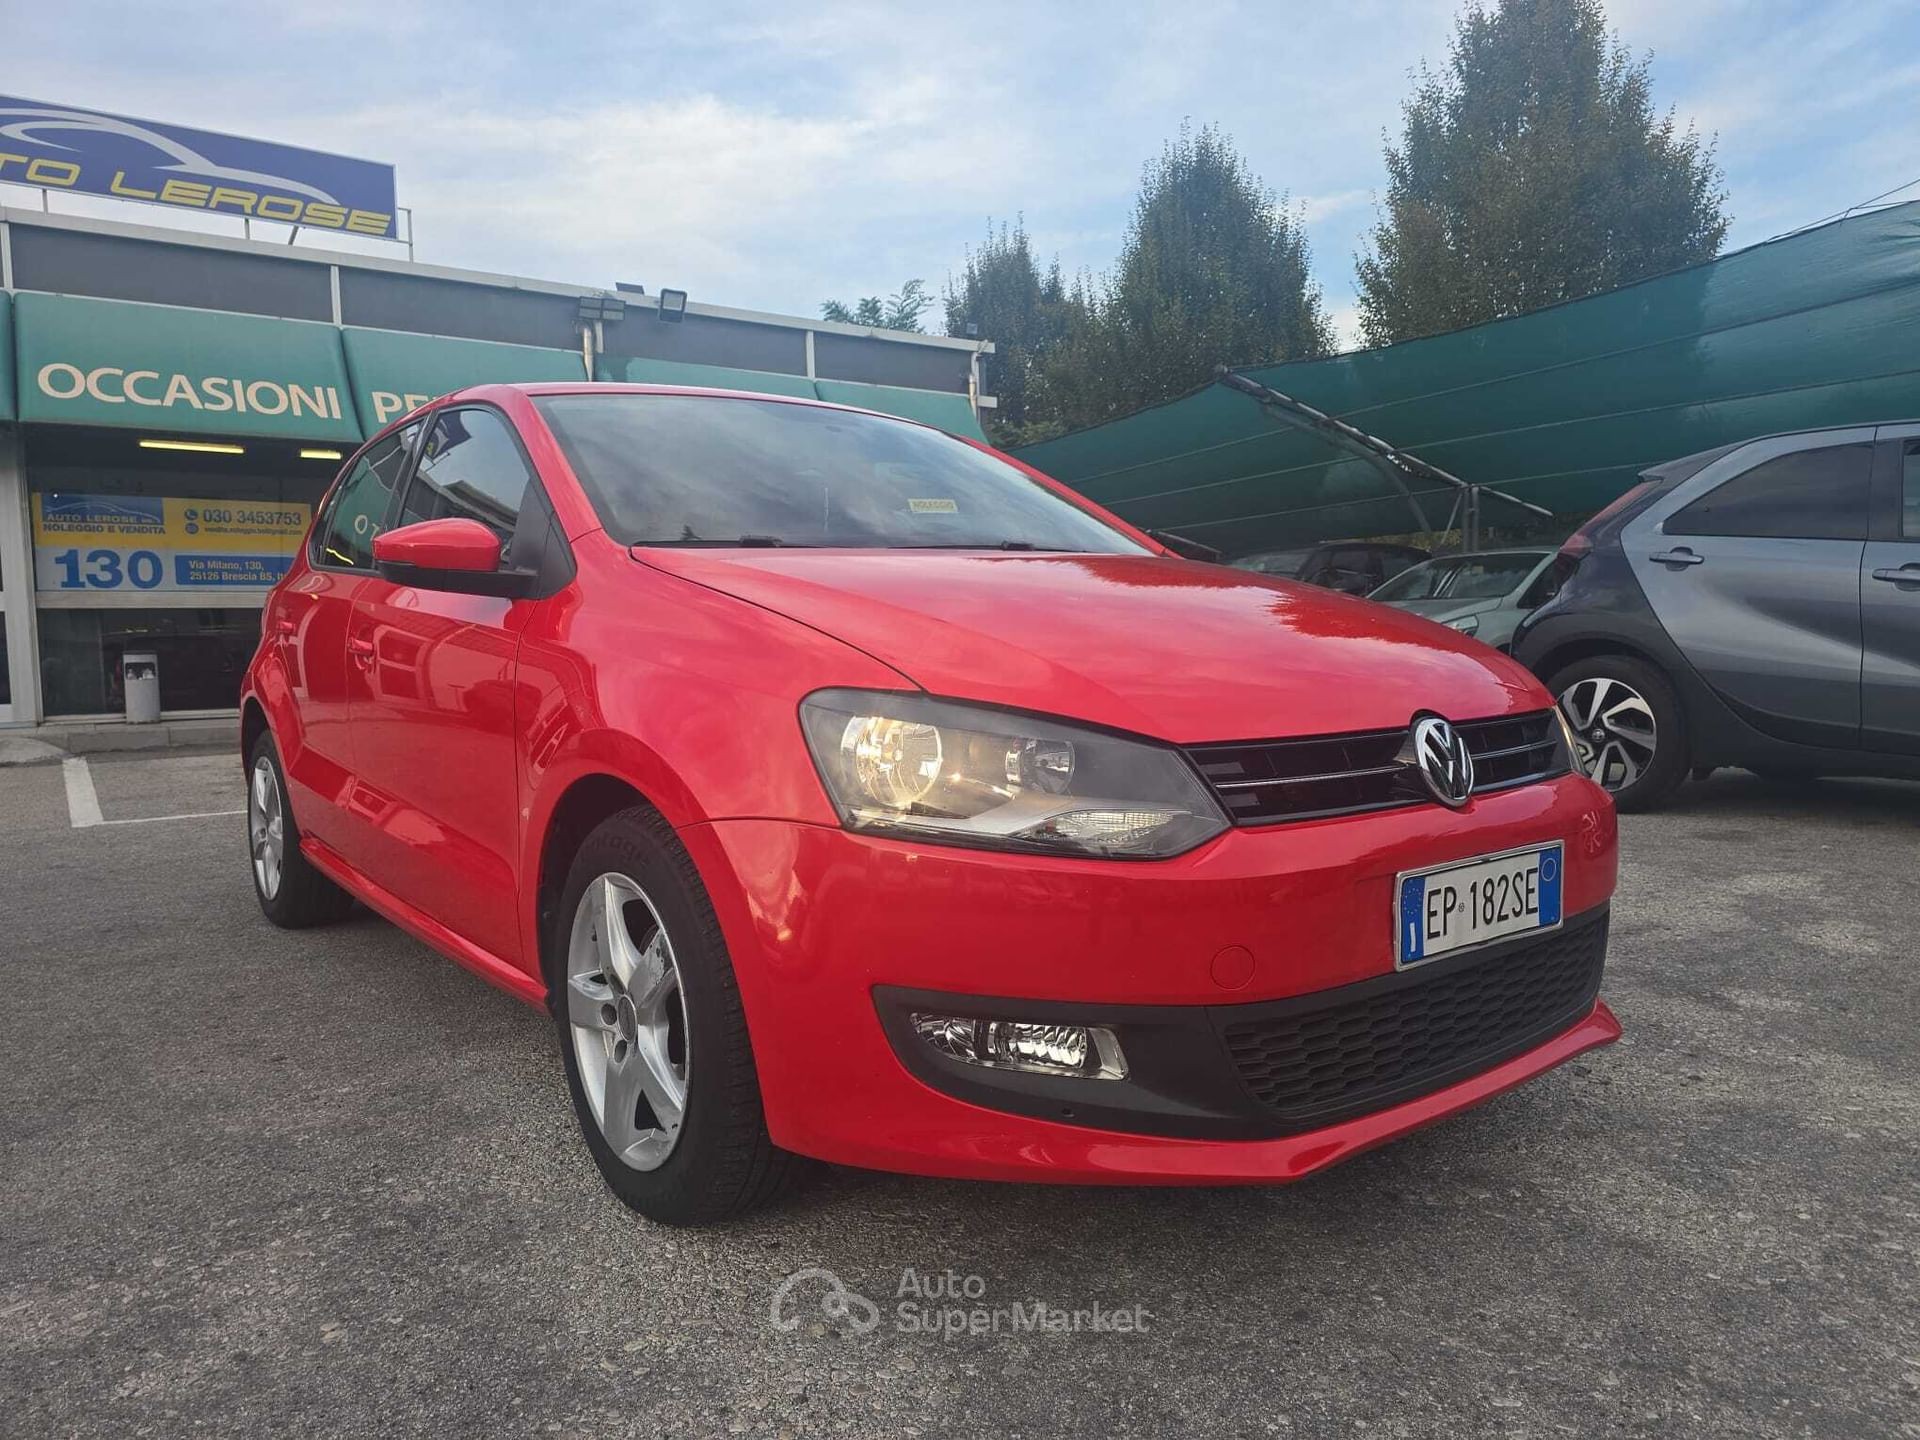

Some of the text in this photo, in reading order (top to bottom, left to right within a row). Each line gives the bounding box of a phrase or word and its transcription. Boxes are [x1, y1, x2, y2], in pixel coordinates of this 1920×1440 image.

[110, 171, 391, 235] LEROSE
[37, 362, 438, 424] OCCASIONI PE
[47, 513, 81, 523] AUTO
[86, 514, 138, 524] LEROSE
[203, 508, 302, 526] 030 3453753
[43, 523, 166, 535] NOLEGGIO E VENDITA
[54, 549, 164, 589] 130
[189, 560, 205, 569] Via
[207, 560, 242, 571] Milano,
[222, 572, 257, 581] Brescia
[1427, 867, 1538, 940] EP 182SE
